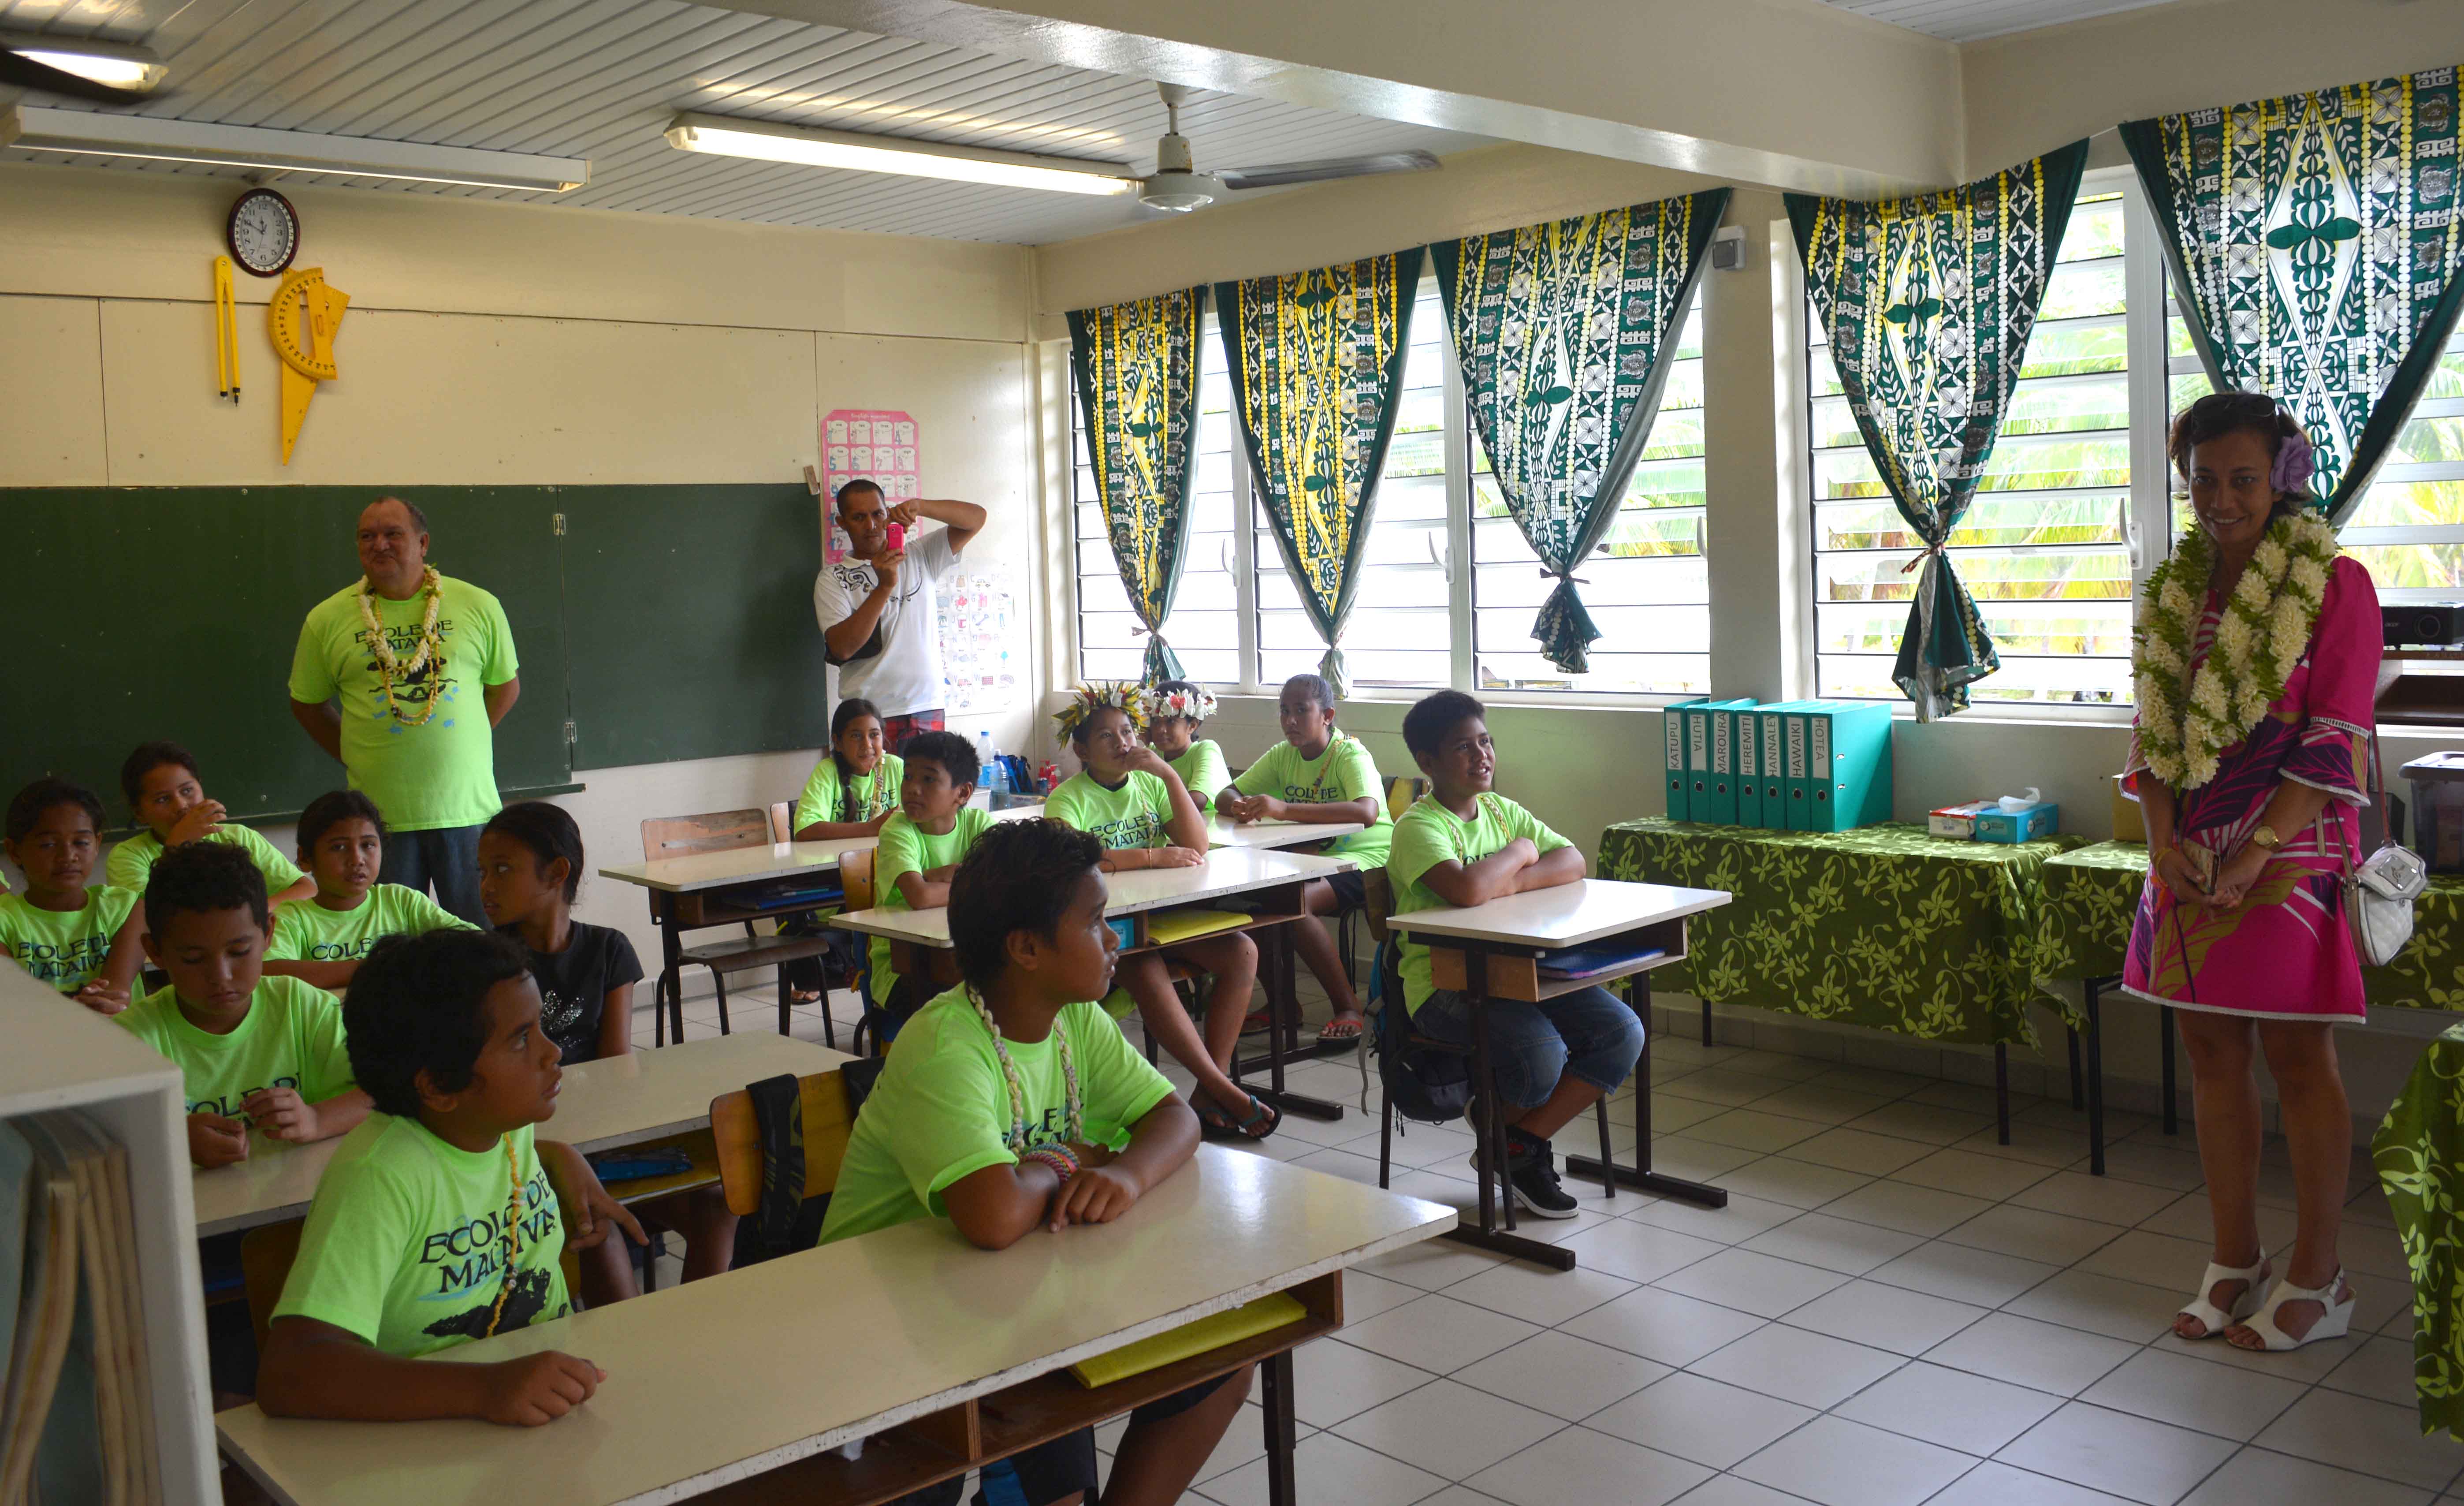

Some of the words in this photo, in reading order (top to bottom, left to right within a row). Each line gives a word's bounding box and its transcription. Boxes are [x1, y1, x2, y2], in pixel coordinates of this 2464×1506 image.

[354, 623, 423, 644] EOLE
[1670, 723, 1679, 768] KATUPU
[1693, 716, 1702, 752] HUTIA
[1717, 712, 1727, 775] MAROURA
[1742, 717, 1752, 774] HEREMITI
[1791, 723, 1801, 776] HAWAIKI
[1815, 719, 1824, 760] HOTEA
[881, 789, 896, 803] DE
[1090, 816, 1146, 837] ECOLE
[17, 939, 88, 960] EOLE
[311, 938, 373, 960] COLE
[527, 1171, 551, 1210] DE
